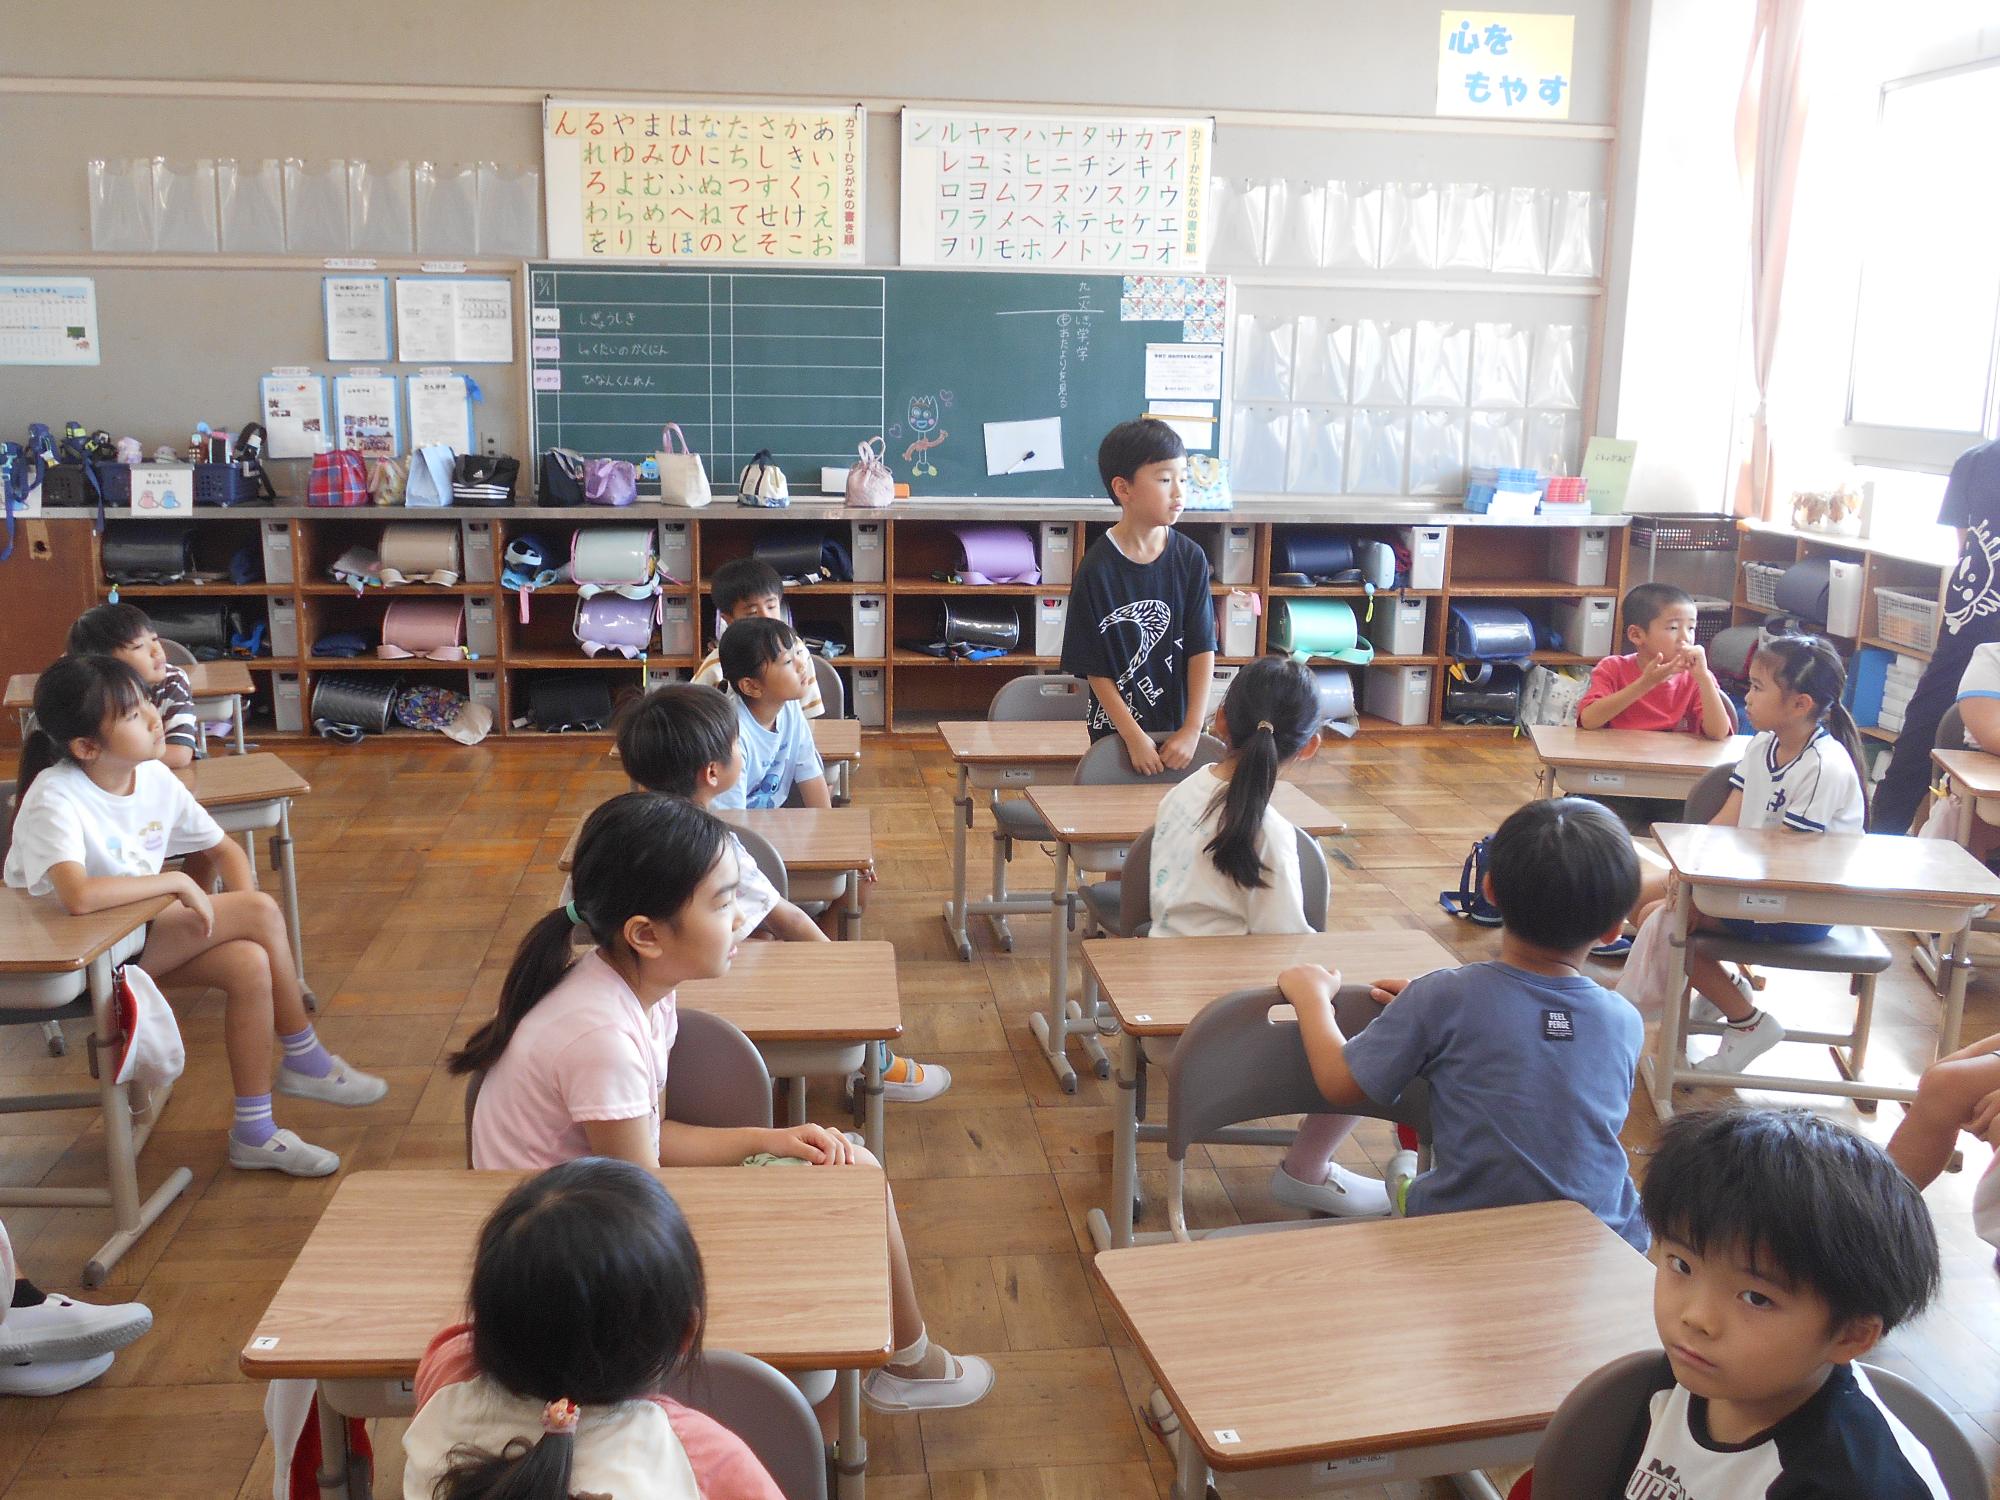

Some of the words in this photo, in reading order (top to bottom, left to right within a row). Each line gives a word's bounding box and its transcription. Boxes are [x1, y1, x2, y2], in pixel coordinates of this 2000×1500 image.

[1448, 20, 1512, 55] 心を
[1464, 71, 1568, 107] もやす
[555, 110, 576, 135] ん
[914, 122, 933, 142] ン
[844, 118, 855, 245] カラーひらがなの書き順
[1186, 128, 1201, 254] カラーかたかなの書き順
[580, 312, 637, 329] しぎょうしき
[582, 375, 656, 388] ひなんくんれん
[1549, 1012, 1567, 1021] FEEL
